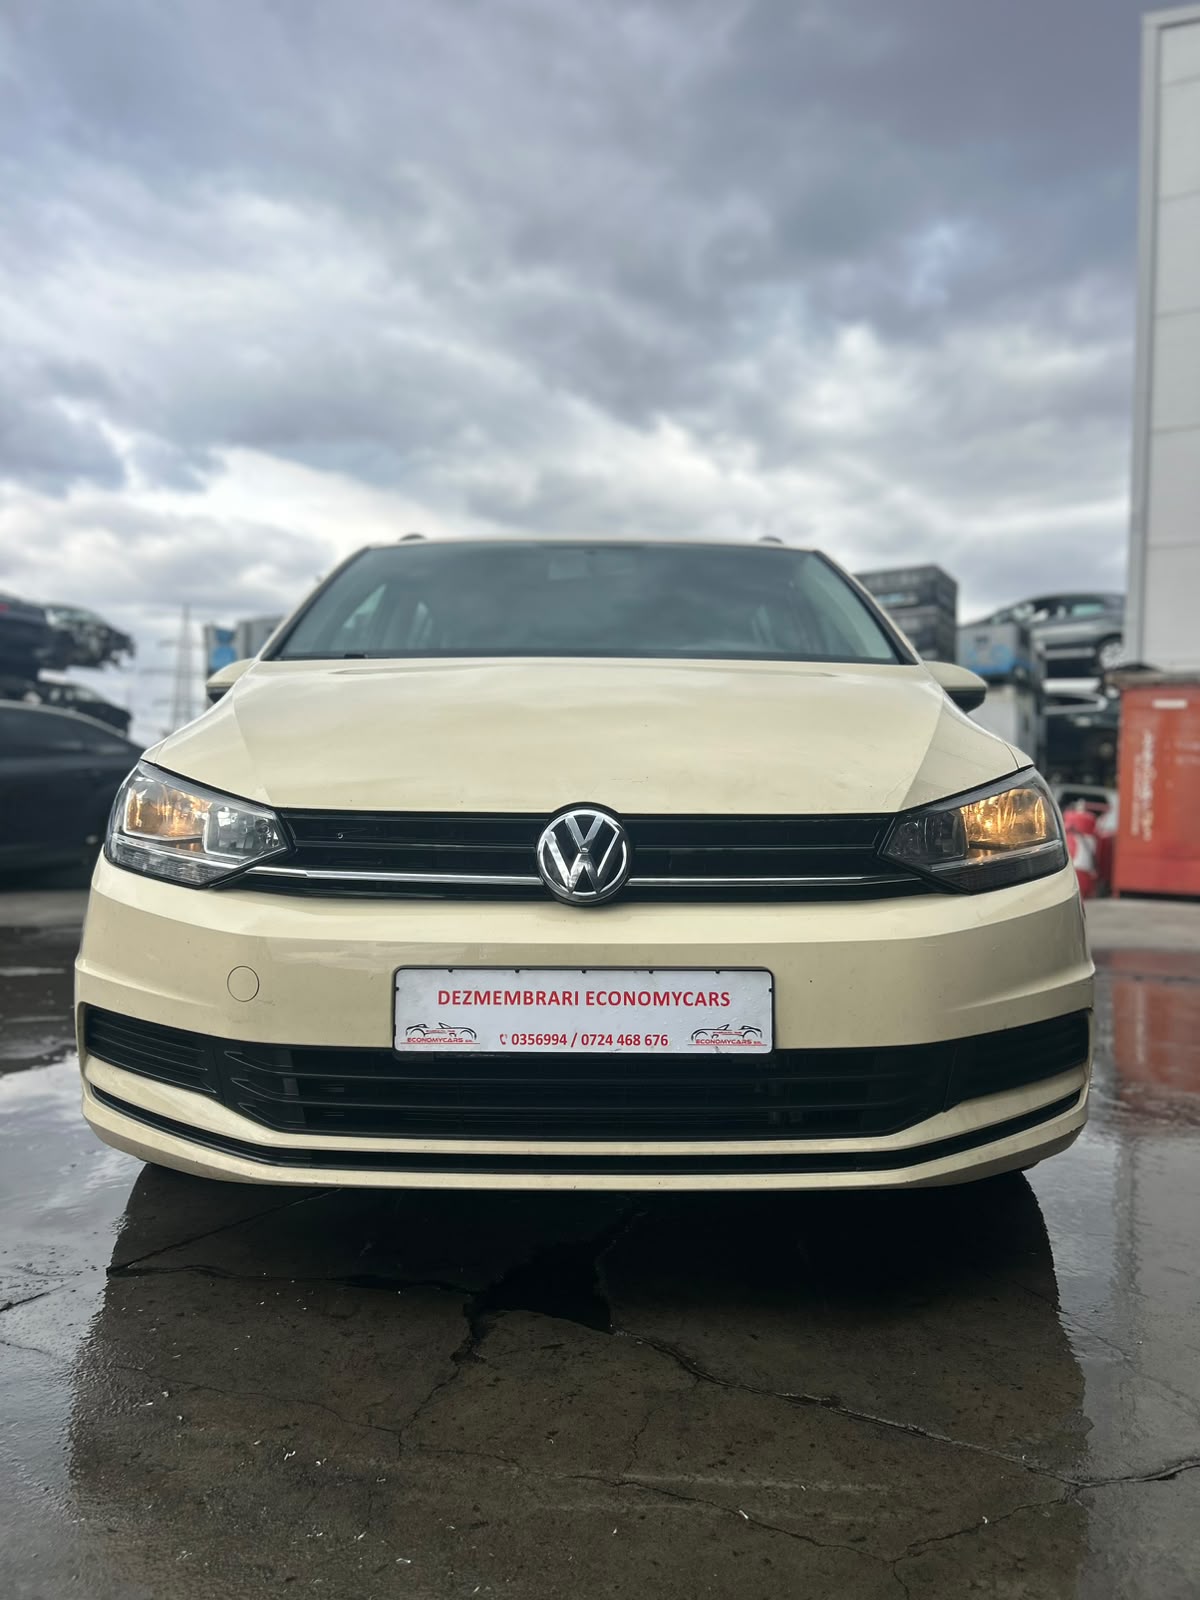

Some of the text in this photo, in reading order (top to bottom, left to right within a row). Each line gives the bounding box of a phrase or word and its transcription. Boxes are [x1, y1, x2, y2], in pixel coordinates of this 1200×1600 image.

[537, 809, 629, 903] VW
[438, 991, 730, 1007] DEZMEMBRARI ECONOMYCARS
[511, 1032, 669, 1048] 0356994 / 0724 468 676
